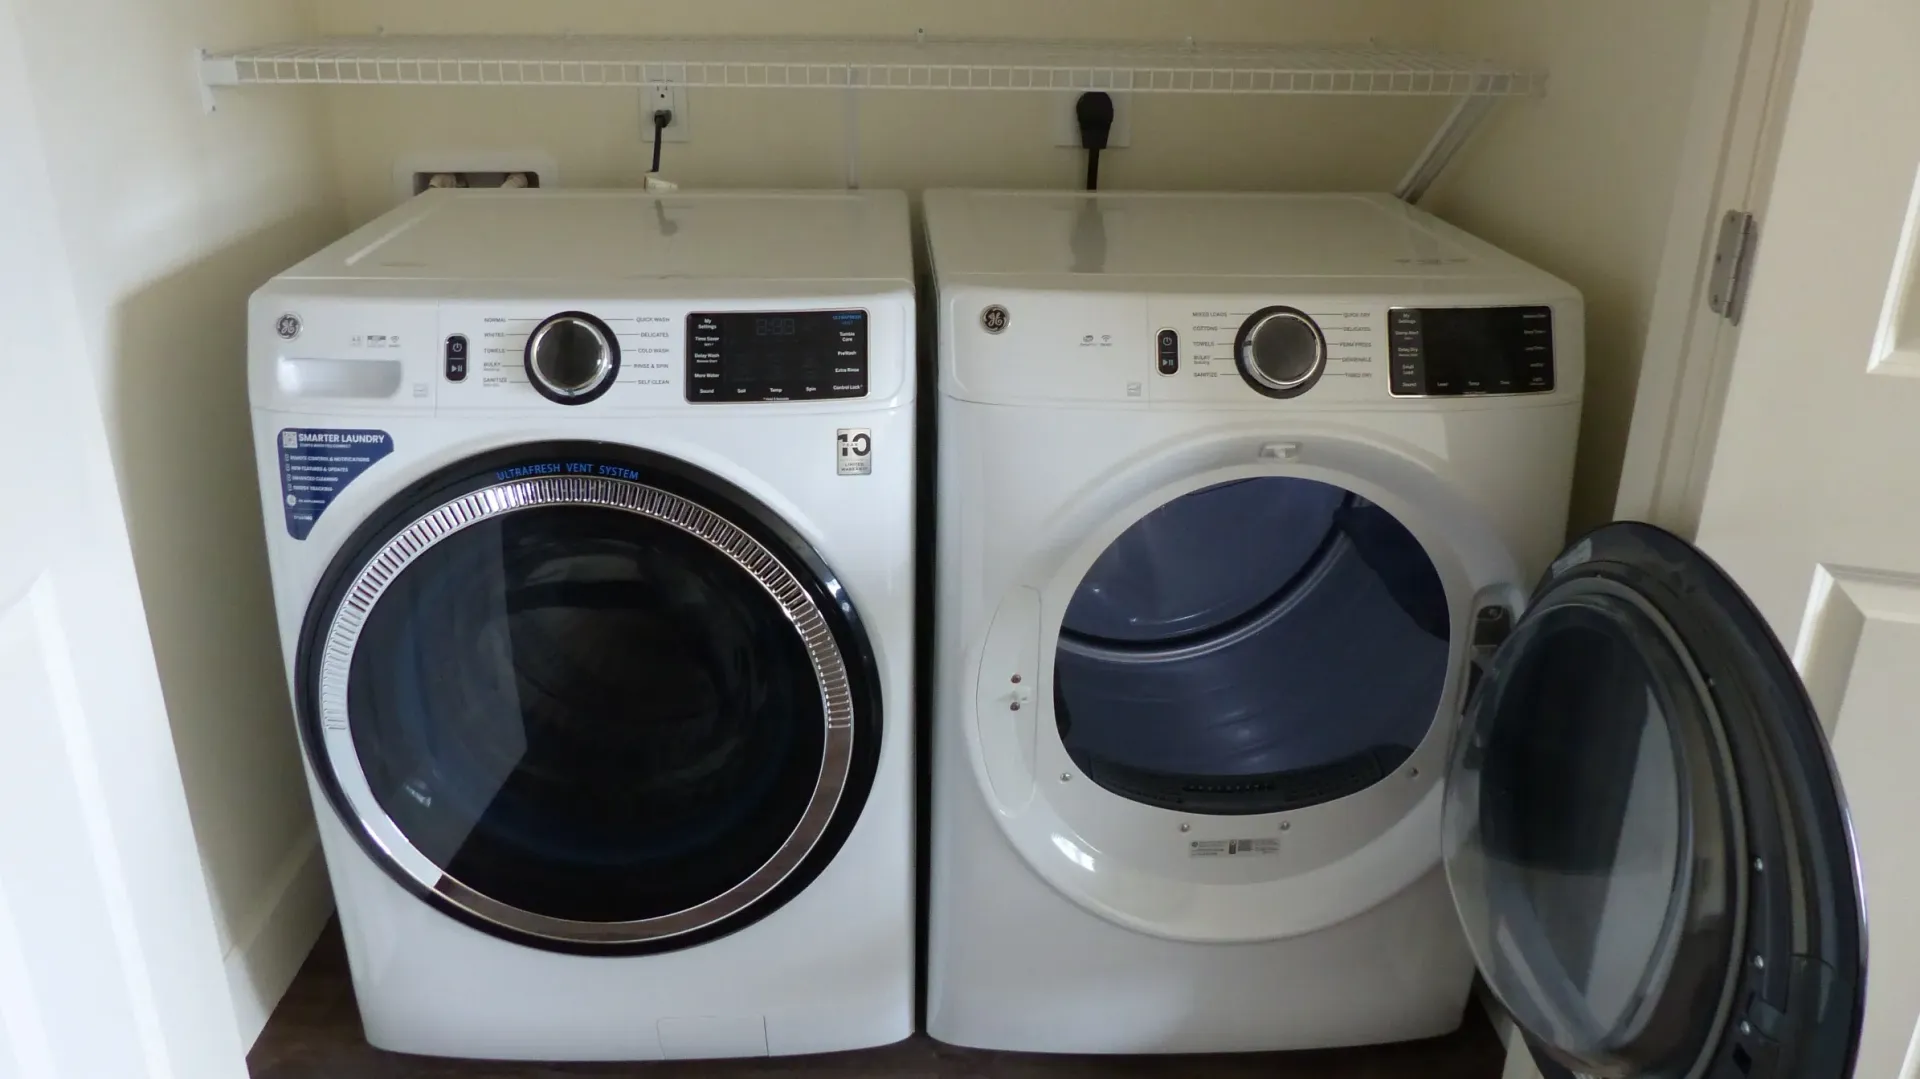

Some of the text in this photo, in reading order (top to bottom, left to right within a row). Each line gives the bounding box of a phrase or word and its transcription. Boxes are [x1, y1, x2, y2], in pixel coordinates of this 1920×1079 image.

[298, 433, 385, 443] SMARTER LAUNDRY
[837, 433, 871, 456] 10
[496, 463, 639, 481] ULTRAFRESH VENT SYSTEM
